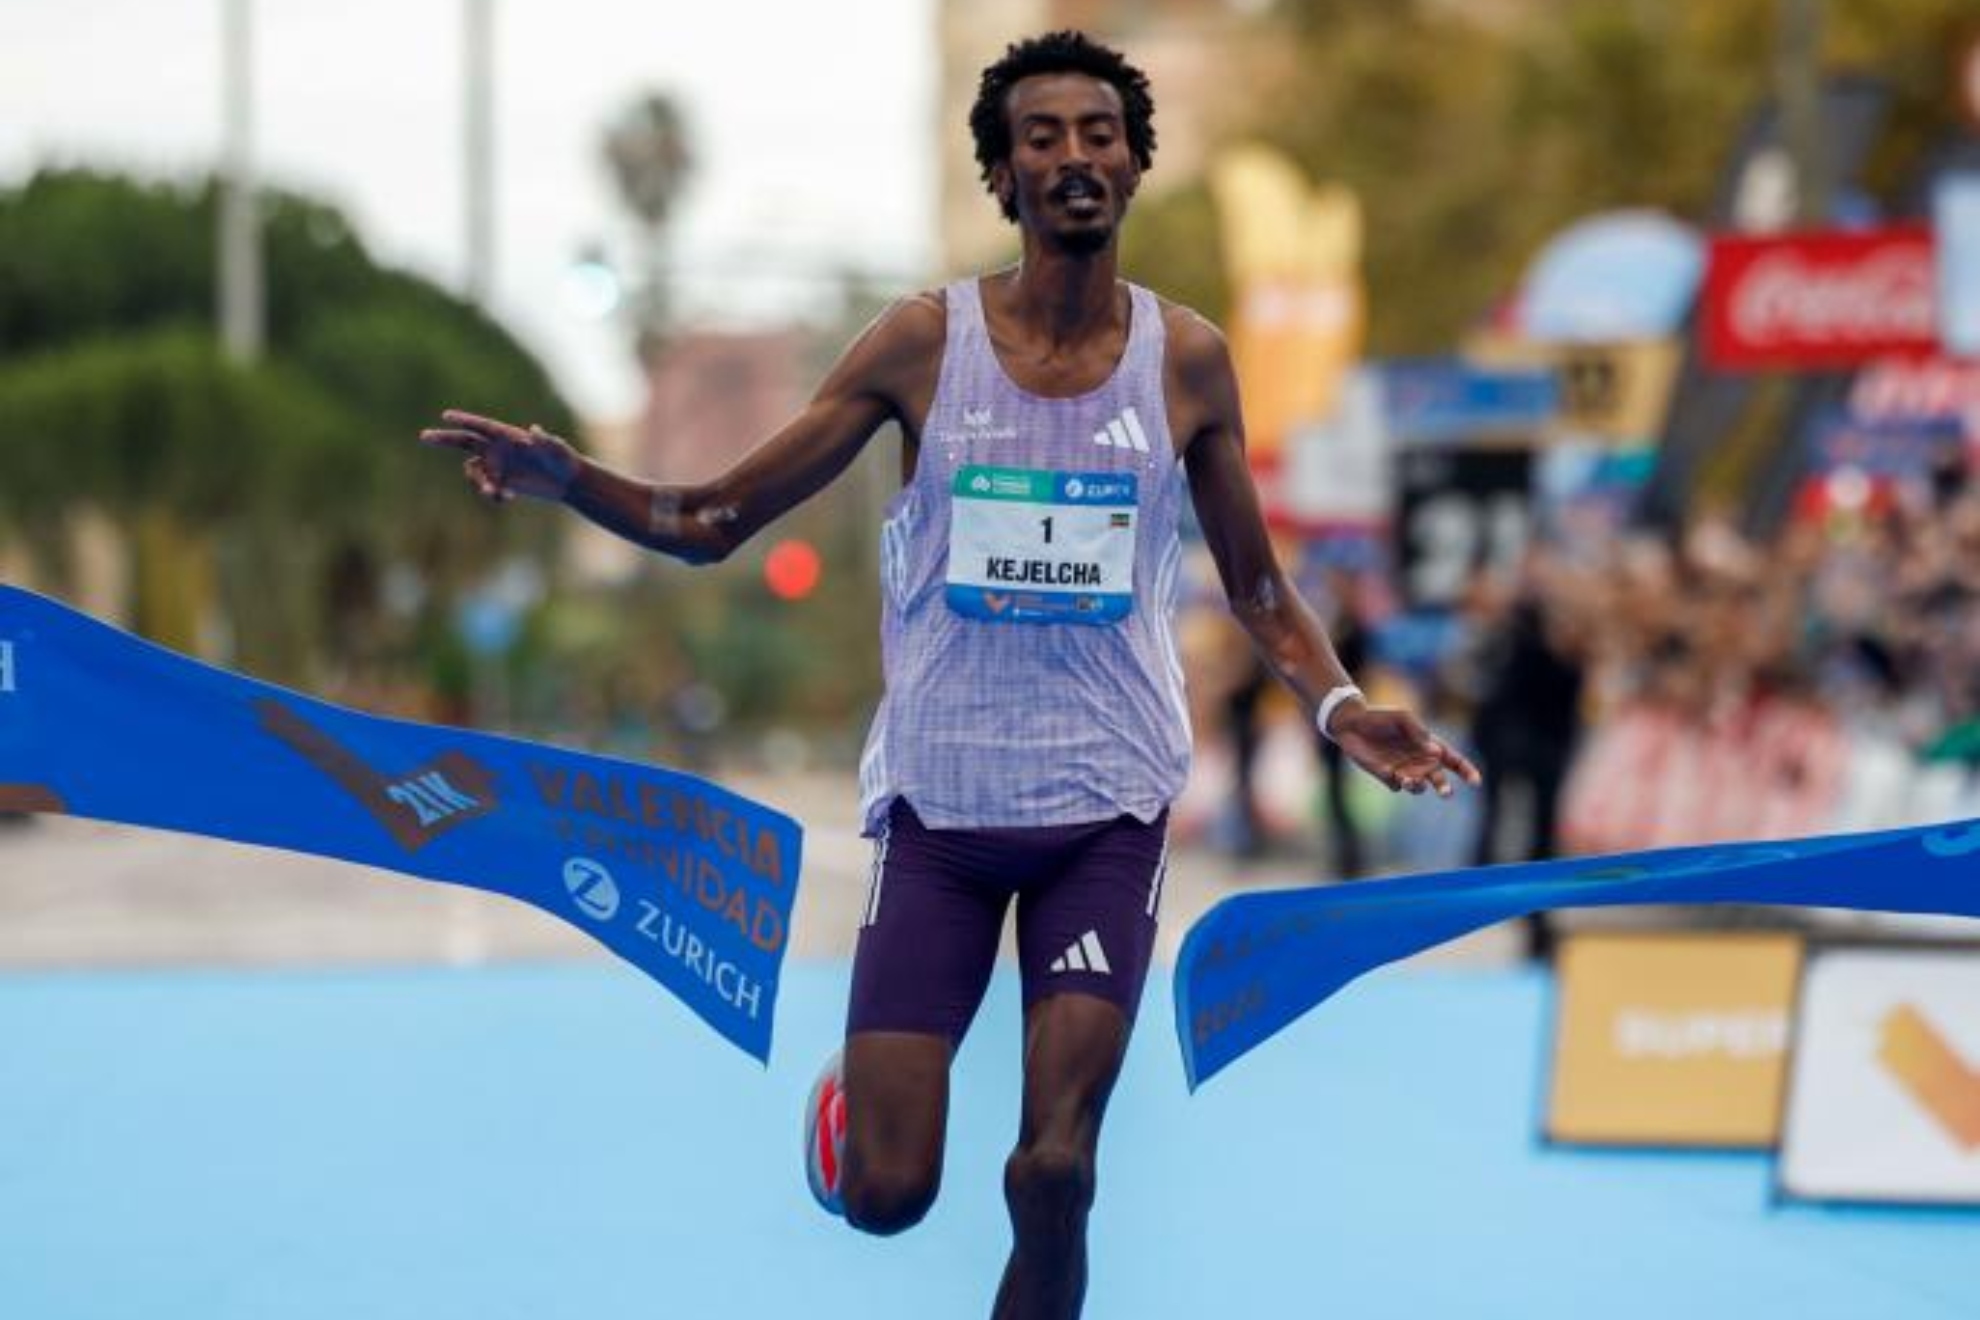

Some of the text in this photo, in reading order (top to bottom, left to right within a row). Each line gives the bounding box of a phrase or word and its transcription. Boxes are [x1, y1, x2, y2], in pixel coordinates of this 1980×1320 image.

[1040, 515, 1055, 544] 1
[986, 557, 1102, 587] KEJELCHA
[386, 770, 480, 828] 21K
[524, 760, 783, 884] VALENCIA
[634, 897, 762, 1020] ZURICH
